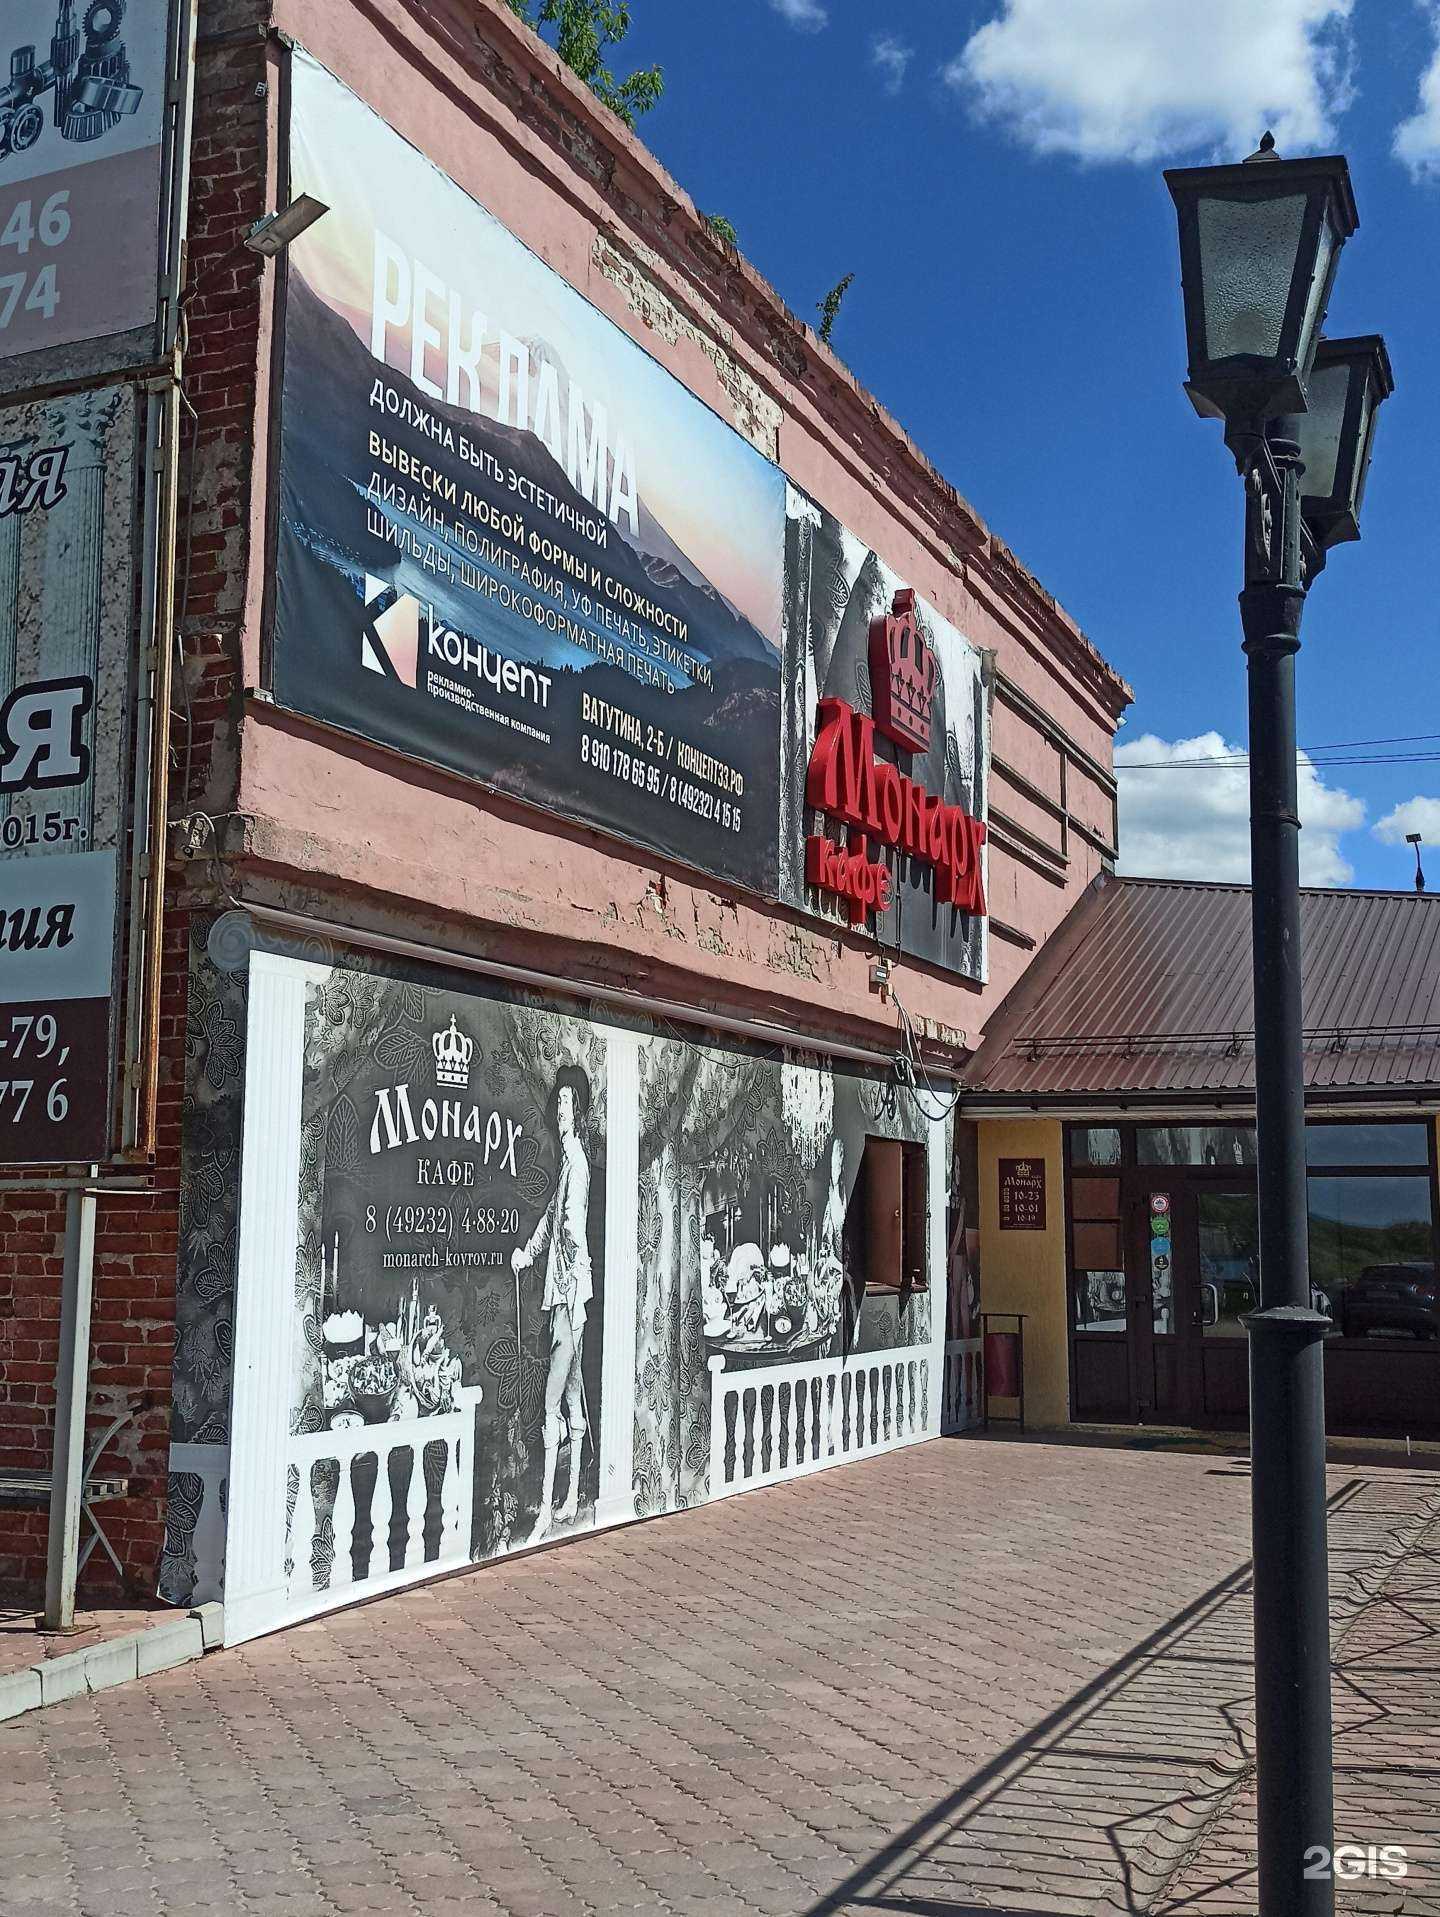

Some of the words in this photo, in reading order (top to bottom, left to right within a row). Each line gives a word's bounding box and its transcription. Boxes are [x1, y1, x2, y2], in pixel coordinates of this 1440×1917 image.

[1, 190, 71, 254] 46
[371, 229, 640, 538] РЕКЛАМА
[370, 378, 455, 453] ДОЛЖНА
[459, 435, 504, 483] БЫТЬ
[508, 468, 607, 549] ЭСТЕТИЧНОЙ
[369, 431, 456, 505] ВЫВЕСКИ
[461, 490, 525, 546] ЛЮБОЙ
[529, 531, 587, 583] ФОРМЫ
[591, 566, 601, 591] И
[604, 578, 688, 642] СЛОЖНОСТИ
[367, 471, 449, 542] ДИЗАЙН,
[454, 521, 568, 610] ПОЛИГРАФИЯ,
[571, 588, 592, 617] УФ
[595, 602, 650, 655] ПЕЧАТЬ,
[652, 635, 714, 692] ЭТИКЕТКИ,
[367, 508, 455, 584] ШИЛЬДЫ,
[461, 562, 624, 668] ШИРОКОФОРМАТНАЯ
[628, 653, 675, 694] ПЕЧАТЬ
[427, 670, 476, 698] рекламно-
[427, 682, 510, 725] производственная
[511, 719, 551, 744] компания
[582, 692, 644, 751] ВАТУТИНА,
[646, 725, 665, 757] 2-Б
[677, 740, 744, 796] КОНЦЕПТ33.РФ
[581, 734, 590, 762] 8
[591, 738, 611, 772] 910
[613, 748, 630, 781] 178
[631, 758, 645, 788] 65
[646, 765, 661, 795] 95
[669, 776, 678, 803] 8
[678, 780, 714, 820] (49232)
[713, 798, 720, 823] 4
[722, 802, 731, 828] 15
[732, 806, 742, 833] 15
[807, 697, 987, 917] Монарх
[0, 810, 88, 848] 015г.
[0, 903, 75, 950] ия
[46, 1078, 69, 1122] 6
[369, 1083, 523, 1177] Монарх
[416, 1158, 475, 1187] КАФЕ
[1004, 1176, 1042, 1189] Монарх
[365, 1205, 377, 1233] 8
[385, 1206, 454, 1242] (49232)
[382, 1247, 504, 1269] monarch-kovrov.ru
